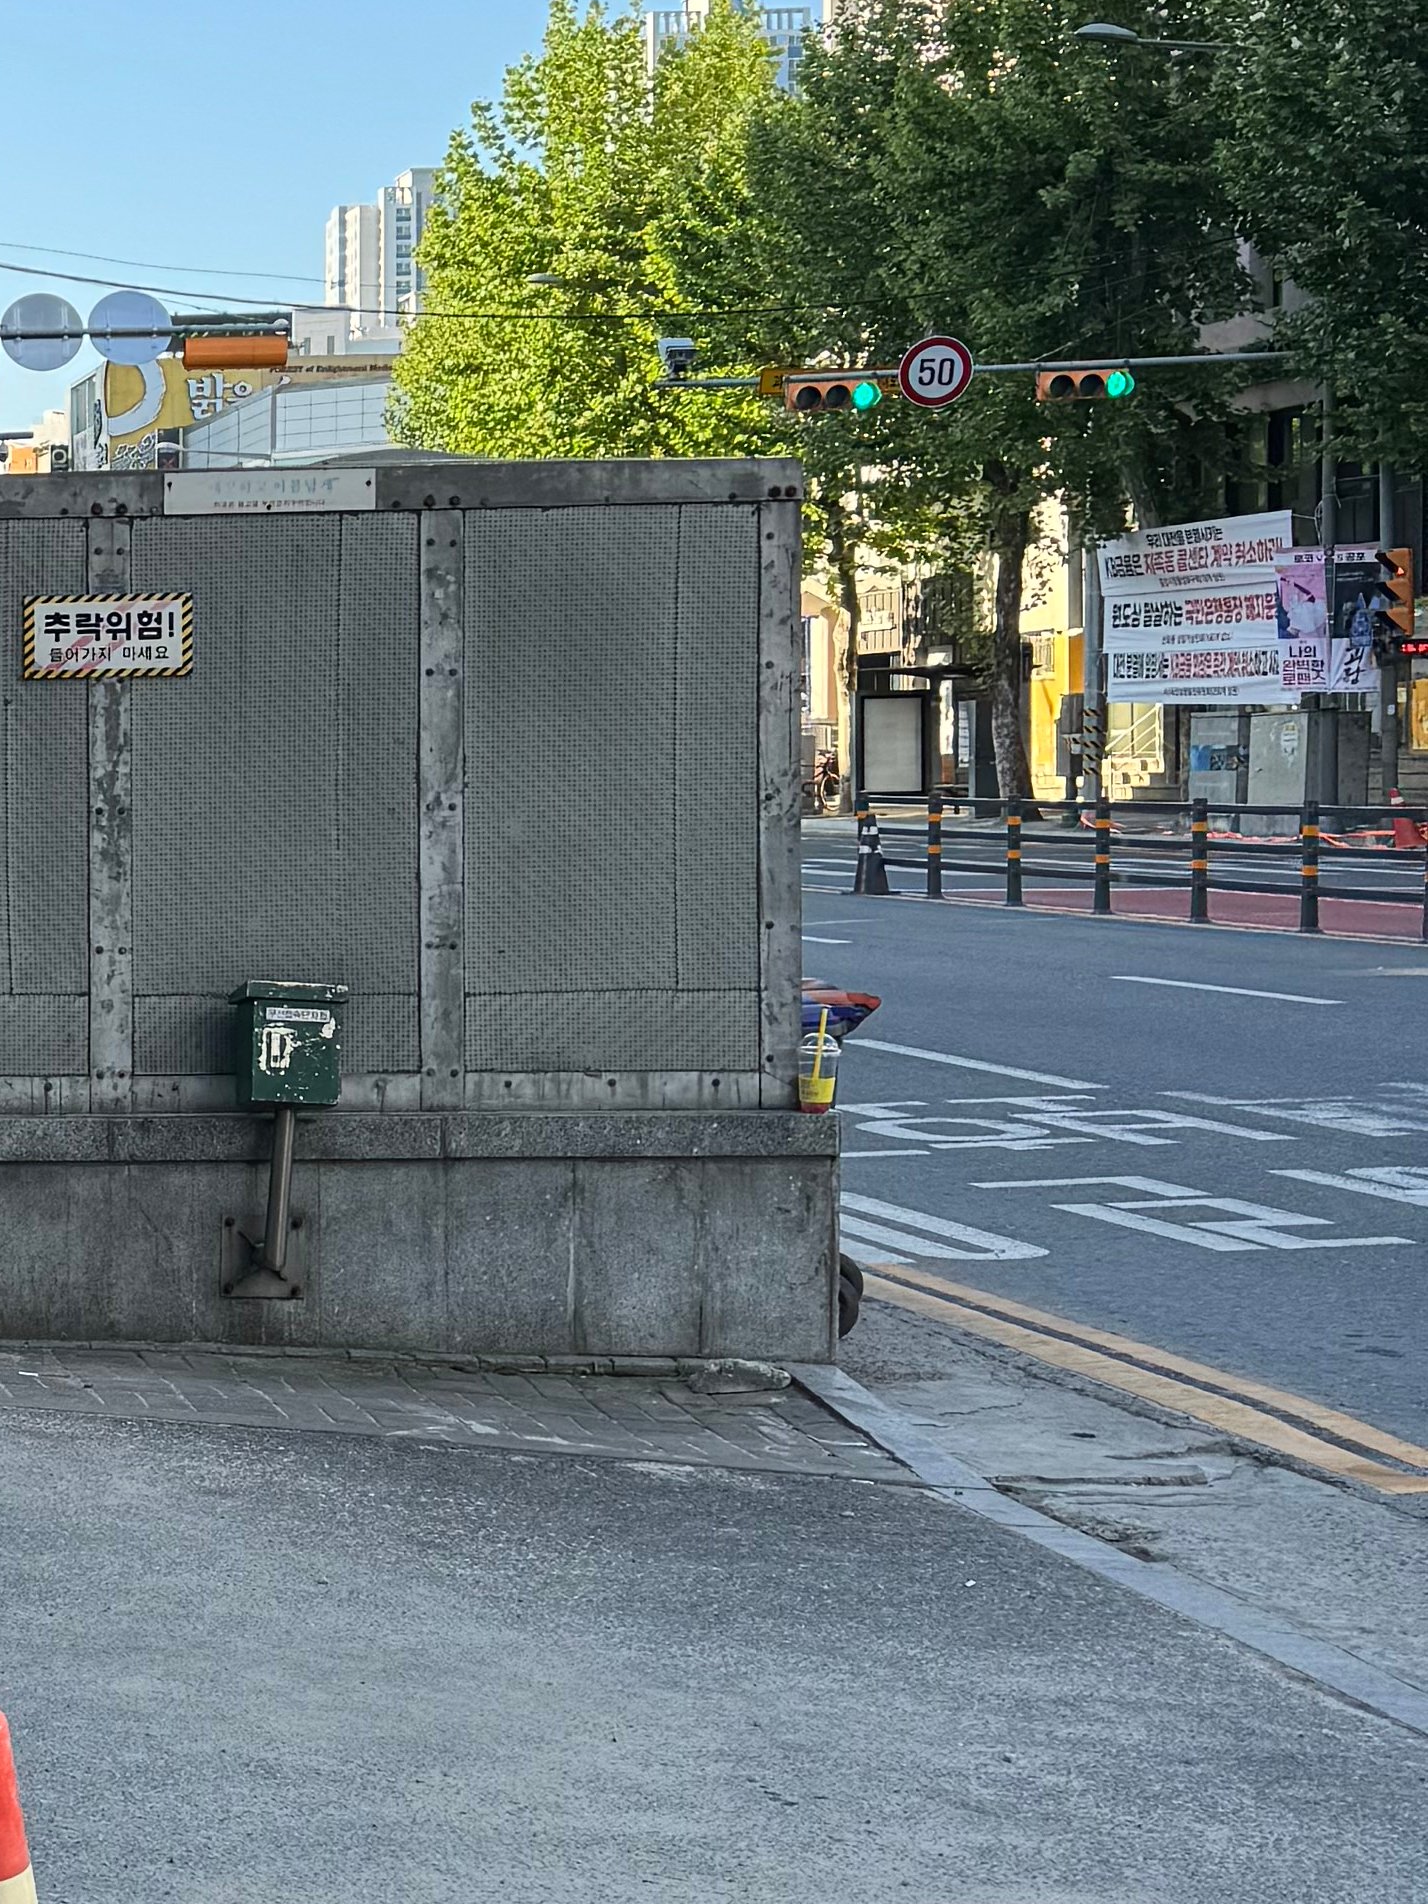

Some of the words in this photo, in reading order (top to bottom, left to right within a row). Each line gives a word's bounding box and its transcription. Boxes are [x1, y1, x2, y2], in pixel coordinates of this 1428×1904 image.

[918, 358, 955, 386] 50
[44, 610, 175, 642] 추락위험!
[50, 646, 112, 662] 들어가지
[122, 645, 169, 661] 마세요
[1289, 645, 1317, 658] 나의
